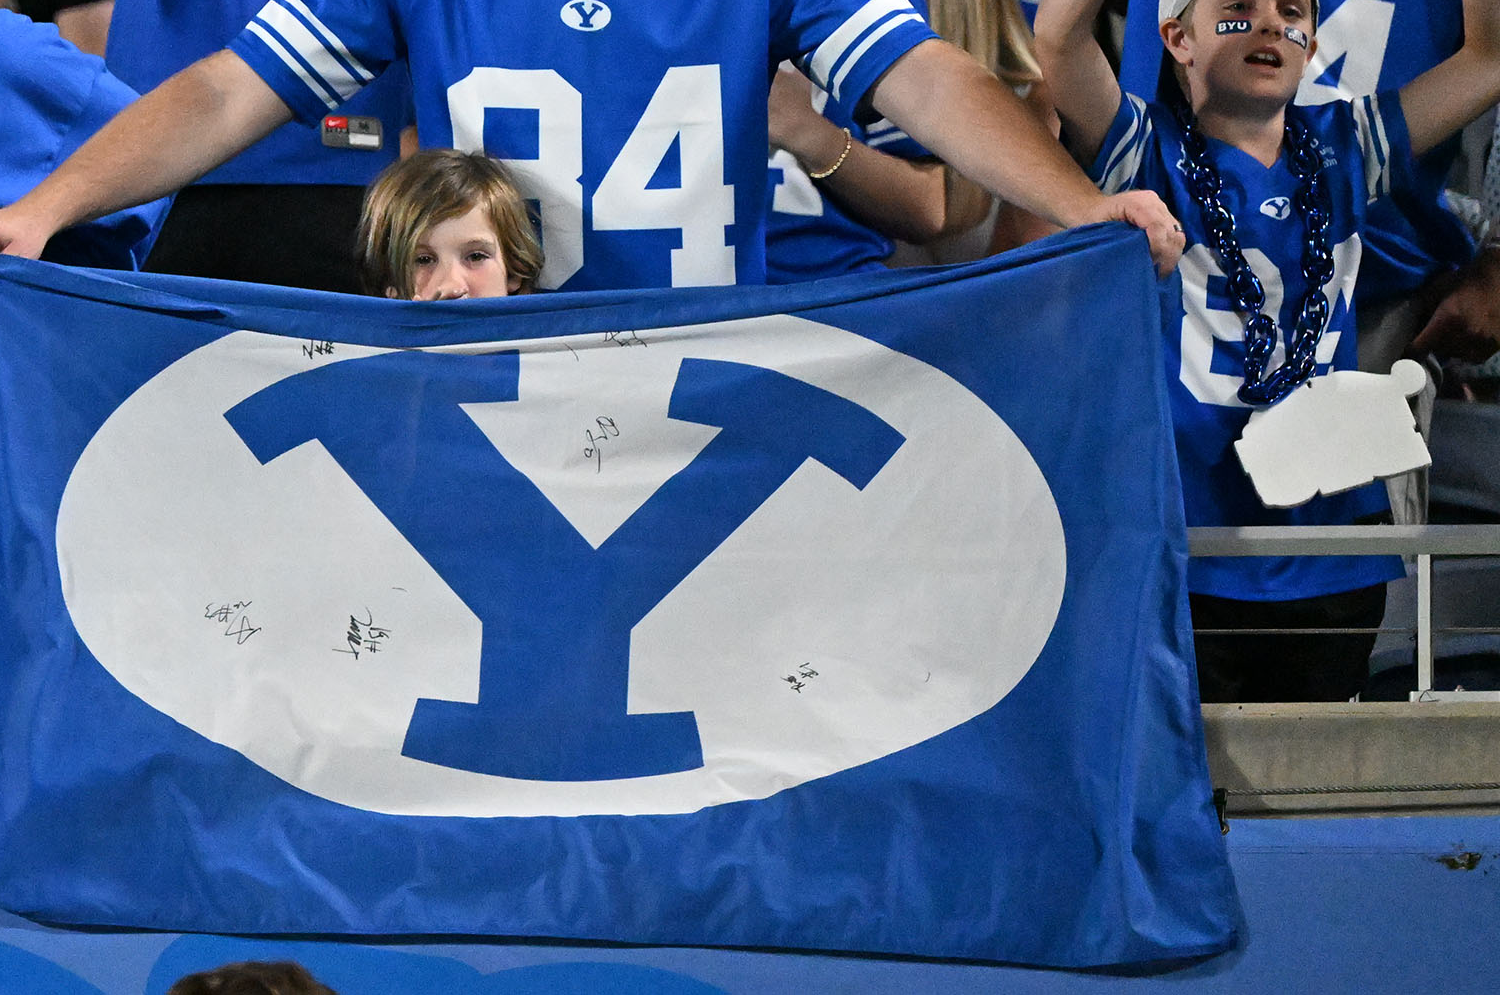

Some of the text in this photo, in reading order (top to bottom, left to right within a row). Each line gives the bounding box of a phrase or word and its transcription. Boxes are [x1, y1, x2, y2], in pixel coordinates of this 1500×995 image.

[1217, 20, 1248, 33] BYU
[446, 64, 736, 291] 84
[222, 349, 907, 783] Y
